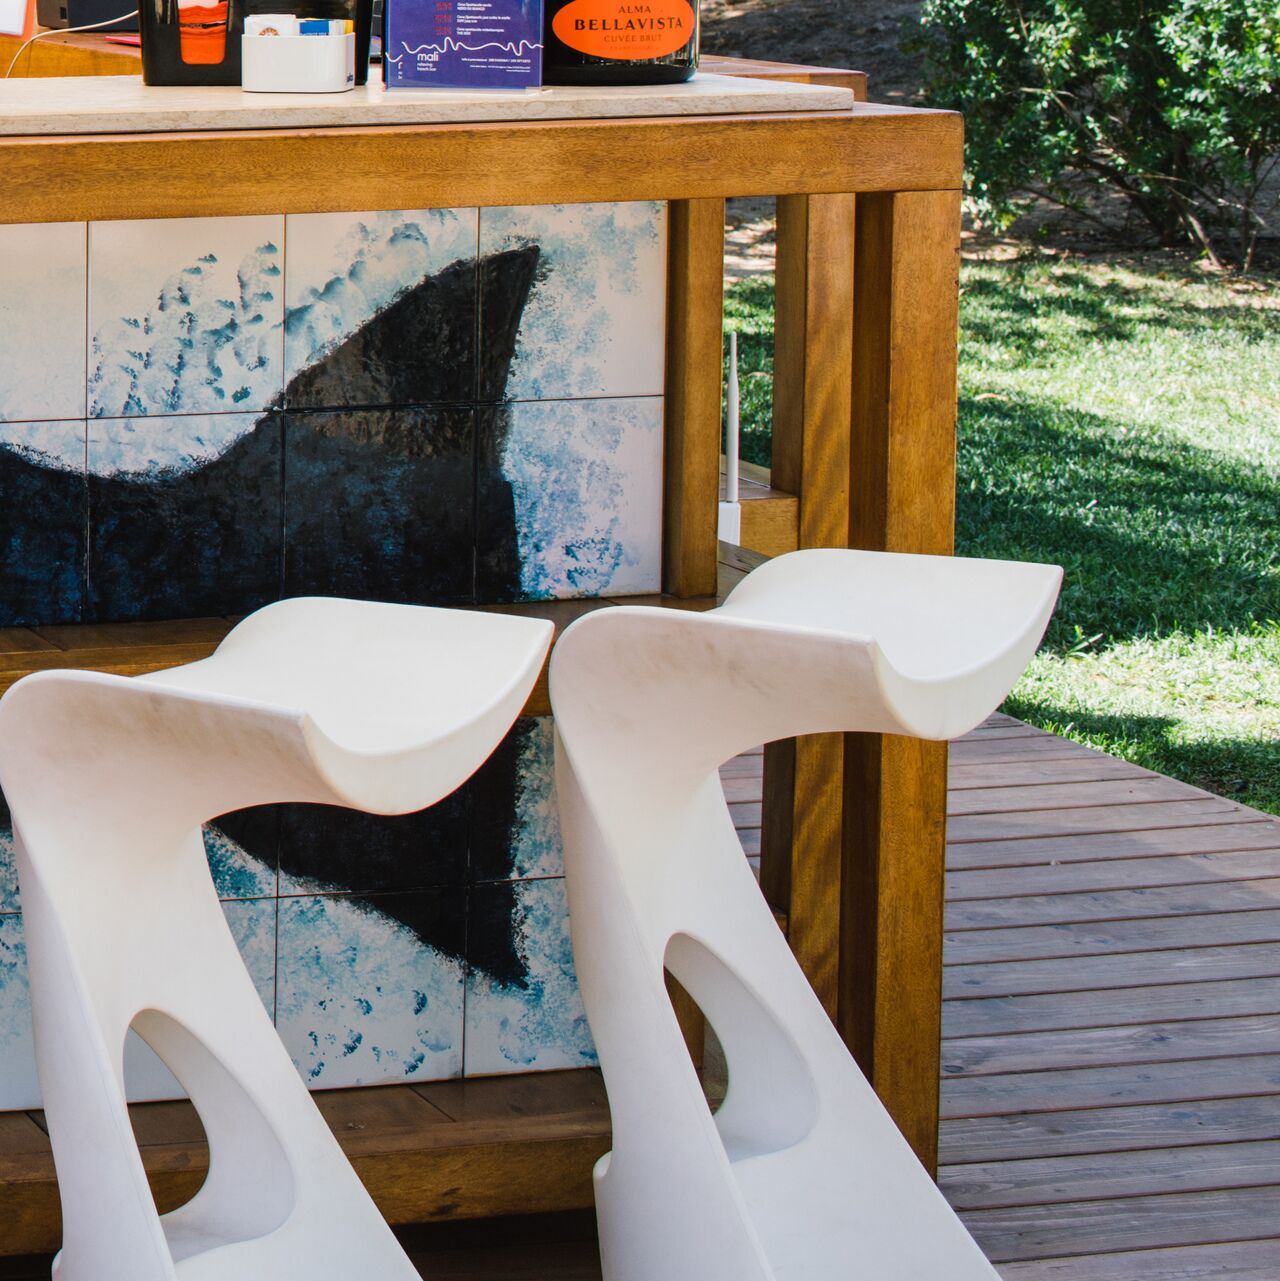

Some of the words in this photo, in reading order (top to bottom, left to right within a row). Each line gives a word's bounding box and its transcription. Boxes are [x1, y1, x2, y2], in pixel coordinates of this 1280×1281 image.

[618, 5, 652, 14] ALMA
[575, 17, 683, 31] BELLAVISTA
[639, 34, 663, 42] BRUT
[417, 51, 439, 61] mali
